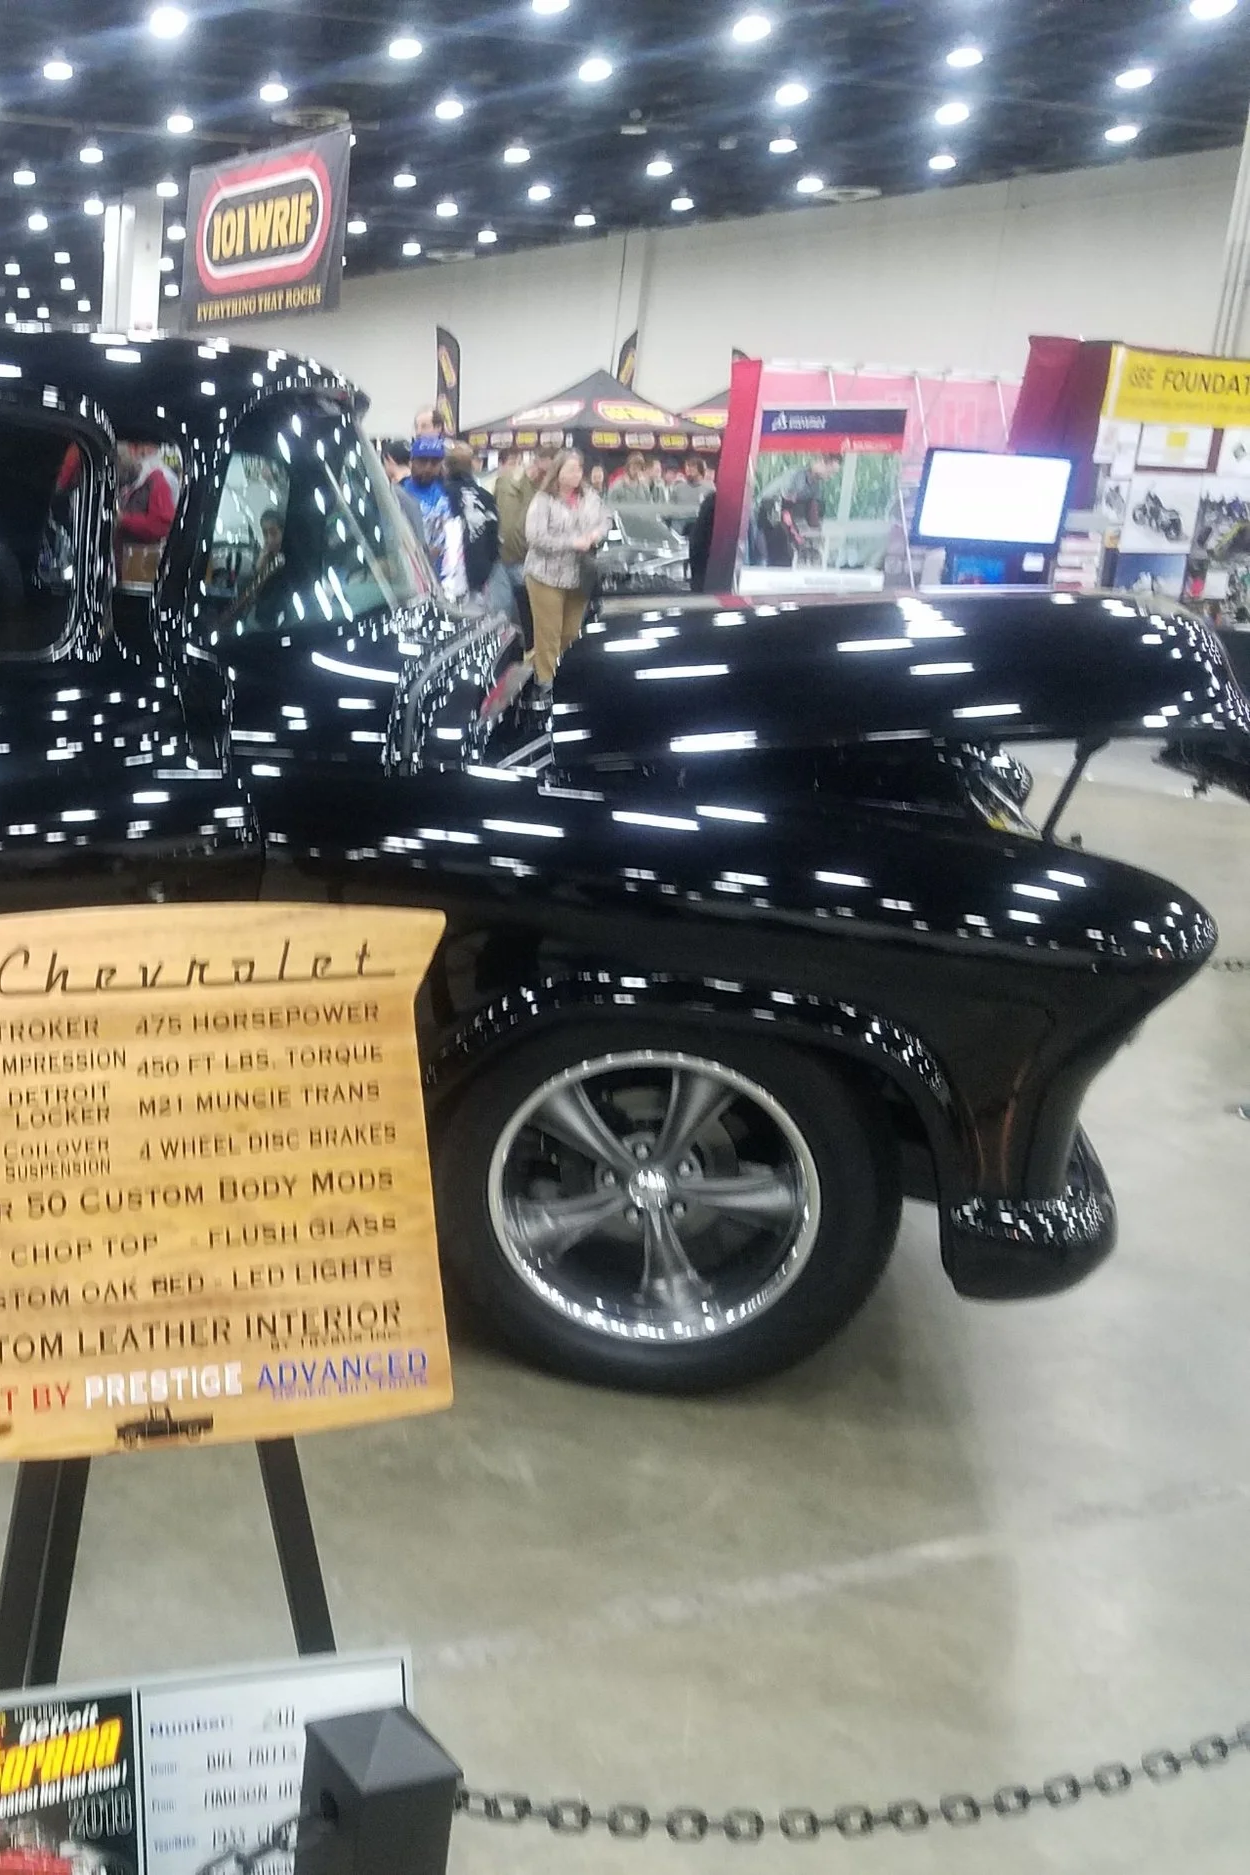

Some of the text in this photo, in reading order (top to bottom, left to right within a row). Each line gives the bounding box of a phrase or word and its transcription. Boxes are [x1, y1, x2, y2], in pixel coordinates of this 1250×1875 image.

[212, 191, 313, 261] 101 WRIF
[197, 283, 322, 322] EVERYTHING THAT ROCKS
[136, 1001, 380, 1037] 475 HORSEPOWER
[137, 1043, 384, 1080] 450 FT LBS. TORQUE
[8, 1081, 111, 1110] DETROIT
[138, 1094, 183, 1119] M21
[301, 1079, 381, 1105] TRANS
[14, 1106, 111, 1131] LOCKER
[139, 1120, 396, 1162] 4 WHEEL DISC BRAKES
[5, 1159, 112, 1185] SUSPENSION
[28, 1188, 68, 1221] 50
[79, 1182, 204, 1216] CUSTOM
[218, 1173, 297, 1204] BODY
[311, 1166, 393, 1196] MODS
[209, 1212, 397, 1249] FLUSH GLASS
[11, 1237, 92, 1269] CHOP
[102, 1231, 158, 1259] TOP
[82, 1275, 138, 1304] OAK
[152, 1271, 204, 1300] BED
[232, 1254, 393, 1291] LED LIGHTS
[78, 1314, 231, 1357] LEATHER
[245, 1299, 400, 1339] INTERIOR
[32, 1380, 70, 1413] BY
[85, 1360, 242, 1409] PRESTIGE
[258, 1347, 427, 1392] ADVANCED
